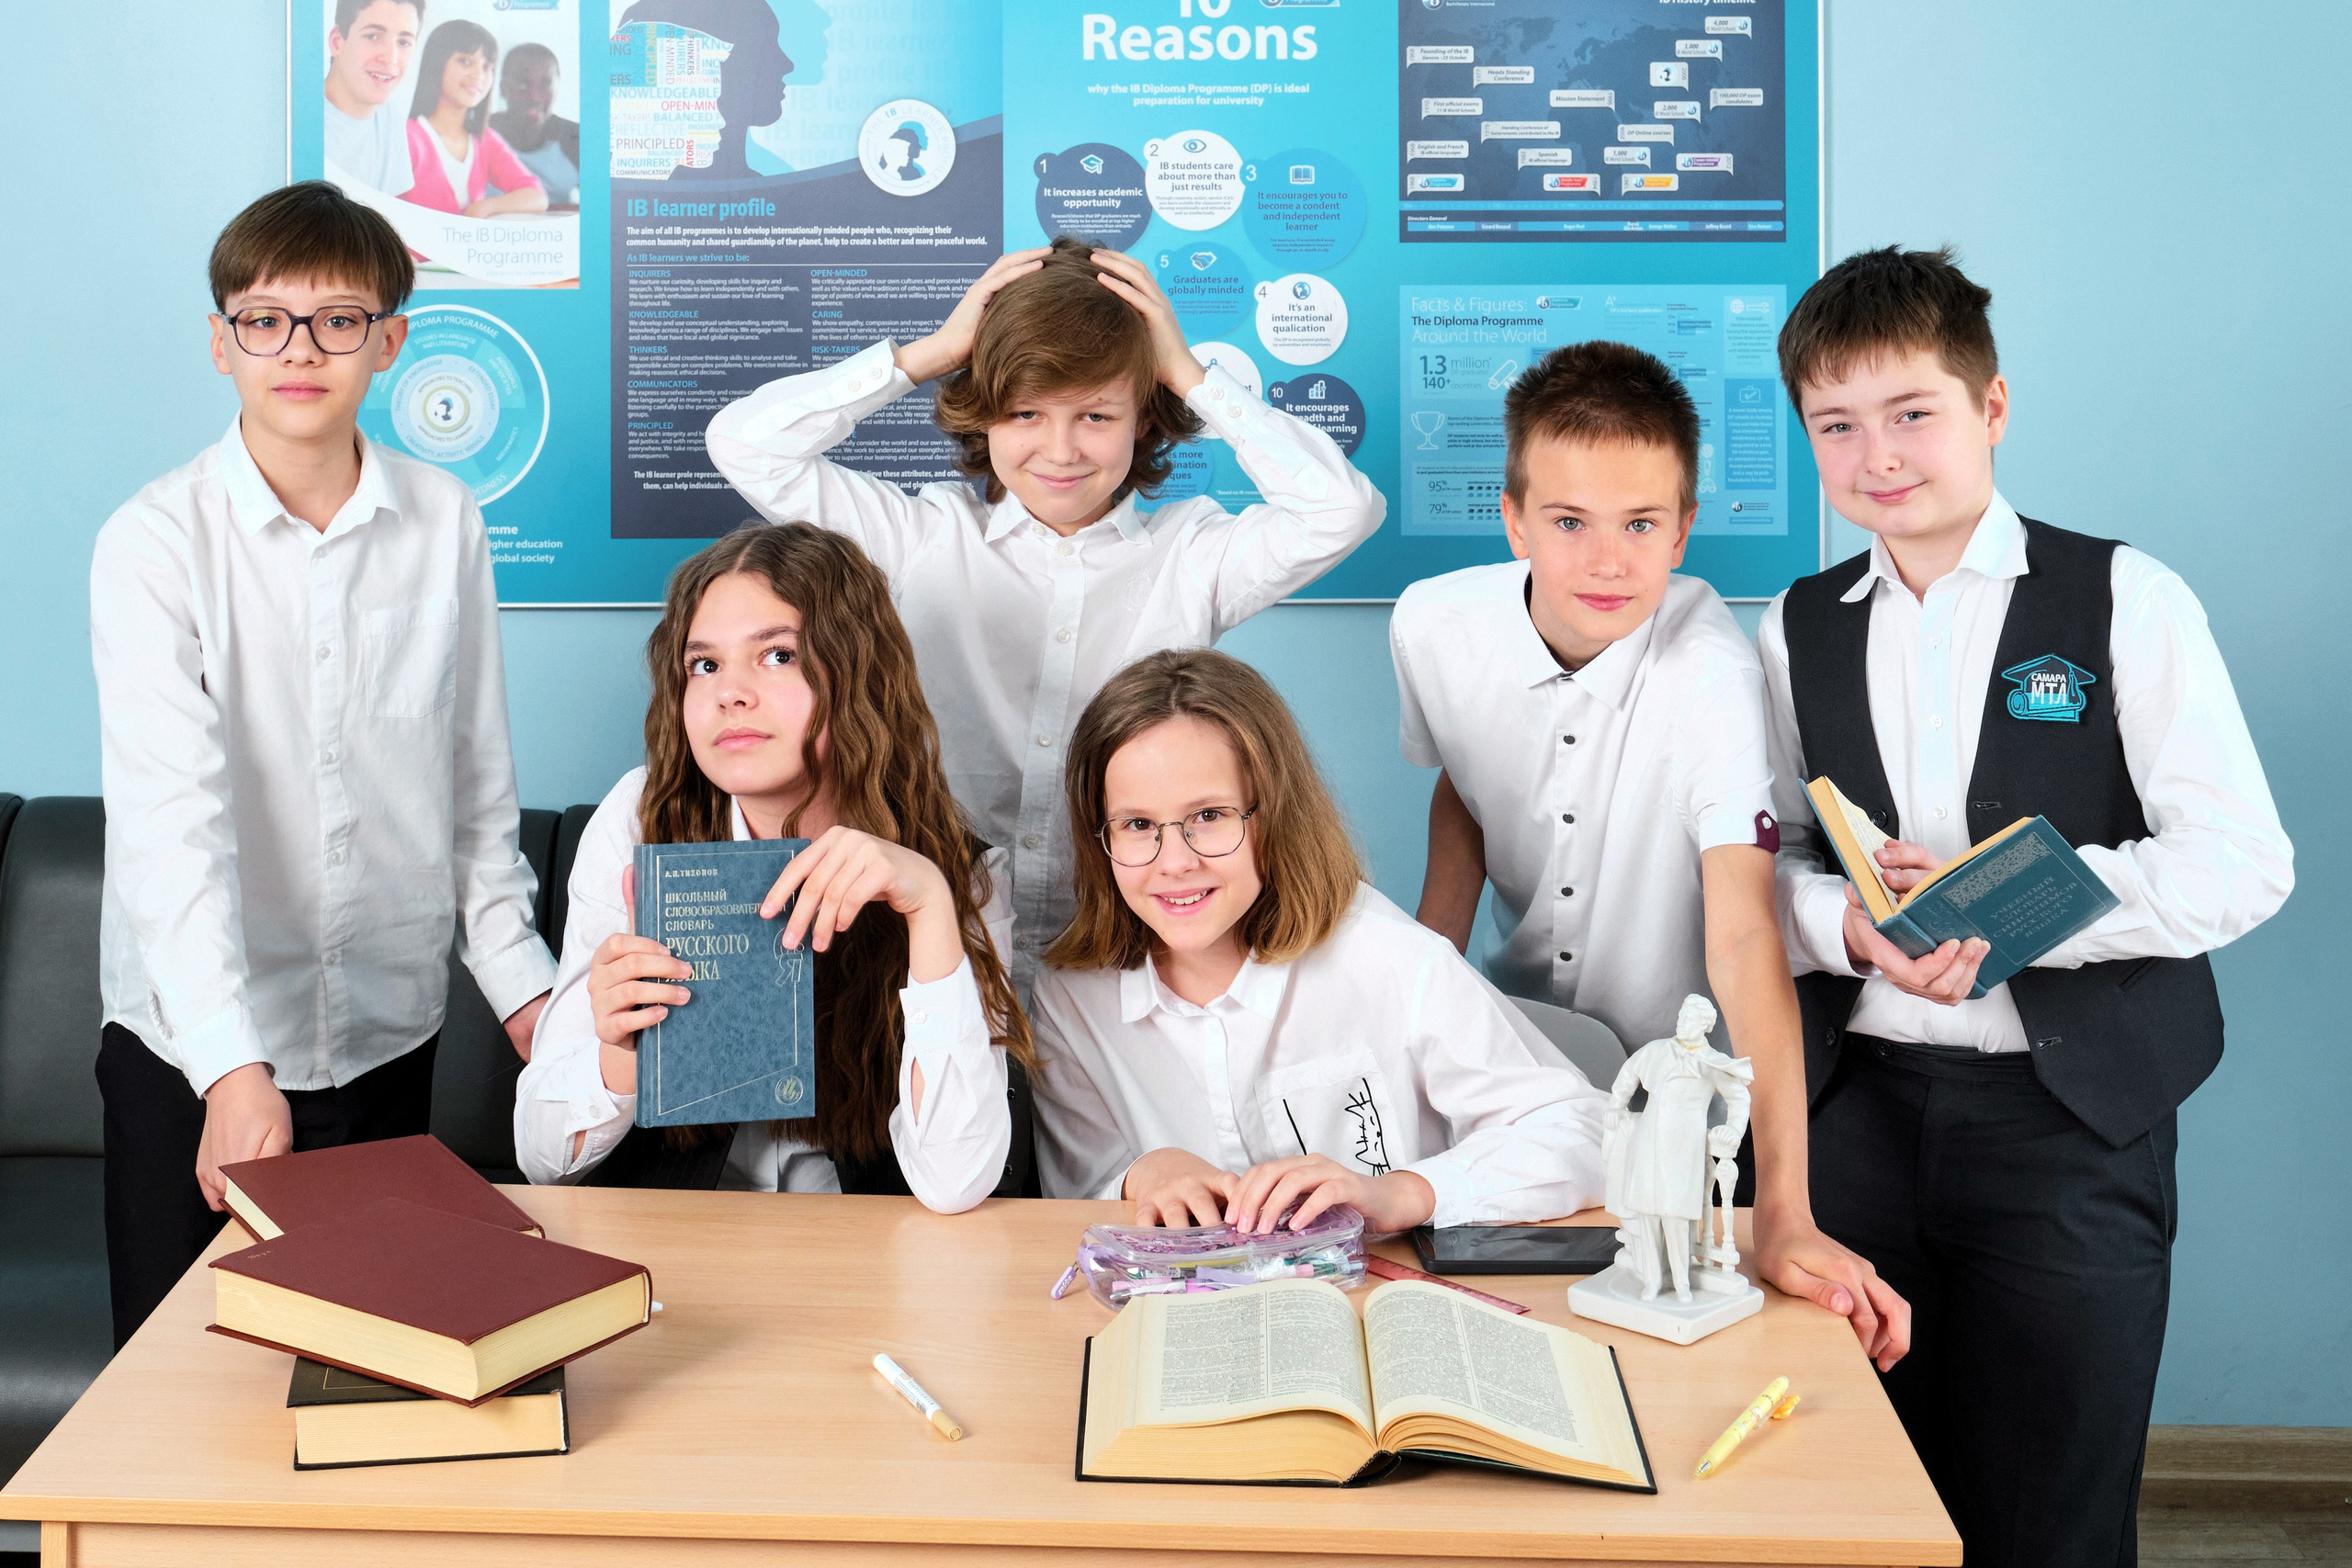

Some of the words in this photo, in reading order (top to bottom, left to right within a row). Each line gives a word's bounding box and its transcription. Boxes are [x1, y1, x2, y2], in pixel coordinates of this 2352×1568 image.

[1082, 13, 1318, 61] Reasons
[610, 87, 718, 98] KNOWLEDGEABLE
[1088, 84, 1110, 96] why
[1110, 84, 1128, 94] the
[1130, 84, 1141, 94] IB
[1142, 84, 1186, 96] Diploma
[1187, 84, 1248, 96] Programme
[1250, 84, 1272, 94] (DP)
[1273, 84, 1283, 93] is
[1284, 84, 1309, 93] ideal
[1133, 95, 1194, 107] preparation
[1195, 95, 1211, 105] for
[1213, 96, 1264, 107] university
[654, 113, 713, 121] BALANCED
[616, 139, 684, 149] PRINCIPLED
[1149, 143, 1158, 156] 2
[616, 159, 671, 167] INQUIRERS
[1158, 172, 1185, 180] about
[1215, 172, 1235, 180] than
[1246, 165, 1257, 181] 3
[1044, 187, 1051, 197] It
[1053, 187, 1096, 197] increases
[1098, 187, 1143, 198] academic
[1171, 183, 1189, 192] just
[1192, 182, 1222, 190] results
[1266, 193, 1317, 201] encourages
[1319, 193, 1336, 201] you
[628, 197, 649, 217] IB
[654, 198, 716, 217] learner
[719, 198, 775, 220] profile
[1064, 198, 1121, 209] opportunity
[1303, 201, 1340, 209] condent
[1283, 211, 1340, 221] independent
[443, 227, 472, 243] The
[476, 227, 489, 243] IB
[494, 227, 562, 245] Diploma
[626, 226, 639, 235] The
[640, 227, 654, 235] aim
[655, 226, 663, 235] of
[663, 226, 673, 235] all
[674, 226, 682, 234] IB
[683, 228, 726, 236] programmes
[728, 226, 733, 234] is
[742, 226, 770, 236] develop
[772, 226, 822, 235] internationally
[823, 226, 850, 234] minded
[851, 226, 875, 235] people
[876, 226, 893, 235] who,
[894, 226, 933, 235] recognizing
[657, 238, 691, 247] humanity
[692, 237, 706, 246] and
[707, 237, 729, 245] shared
[730, 237, 775, 247] guardianship
[777, 237, 785, 245] of
[786, 237, 797, 245] the
[798, 237, 823, 247] planet,
[824, 237, 840, 247] help
[878, 237, 900, 245] better
[935, 237, 964, 246] peaceful
[468, 248, 563, 268] Programme
[626, 252, 638, 264] As
[639, 252, 648, 263] IB
[649, 254, 684, 263] learners
[1160, 255, 1169, 268] 5
[628, 270, 671, 278] INQUIRERS
[1168, 286, 1205, 296] globally
[1208, 286, 1244, 294] minded
[1259, 287, 1267, 298] 4
[1289, 303, 1301, 311] It's
[1412, 297, 1451, 314] Facts
[1453, 297, 1464, 312] &
[1470, 297, 1527, 314] Figures:
[1272, 313, 1332, 321] international
[1411, 316, 1431, 325] The
[1434, 316, 1478, 328] Diploma
[1482, 316, 1544, 328] Programme
[445, 316, 500, 339] PROGRAMME
[1273, 324, 1325, 334] qualication
[1412, 328, 1469, 344] Around
[1474, 329, 1498, 343] the
[1502, 328, 1546, 343] World
[811, 345, 859, 354] RISK-TAKERS
[1419, 355, 1447, 375] 1.3
[1450, 381, 1482, 389] countries
[1272, 388, 1283, 398] 10
[1295, 404, 1350, 414] encourages
[1327, 413, 1345, 423] and
[490, 539, 513, 550] igher
[515, 539, 562, 548] education
[522, 553, 555, 564] society
[2030, 672, 2067, 683] САМАРА
[2030, 682, 2067, 705] МТЛ
[665, 889, 727, 904] ШКОЛЬНЫЙ
[1990, 876, 2054, 919] УЧЕБНЫЙ
[1994, 882, 2077, 938] СИНОНИМОВ
[2001, 886, 2056, 924] СЛОВАРЬ
[2009, 895, 2073, 938] РУССКОГО
[665, 919, 715, 931] СЛОВАРЬ
[2025, 908, 2069, 939] ЯЗЫКА
[665, 933, 750, 957] РУССКОГО
